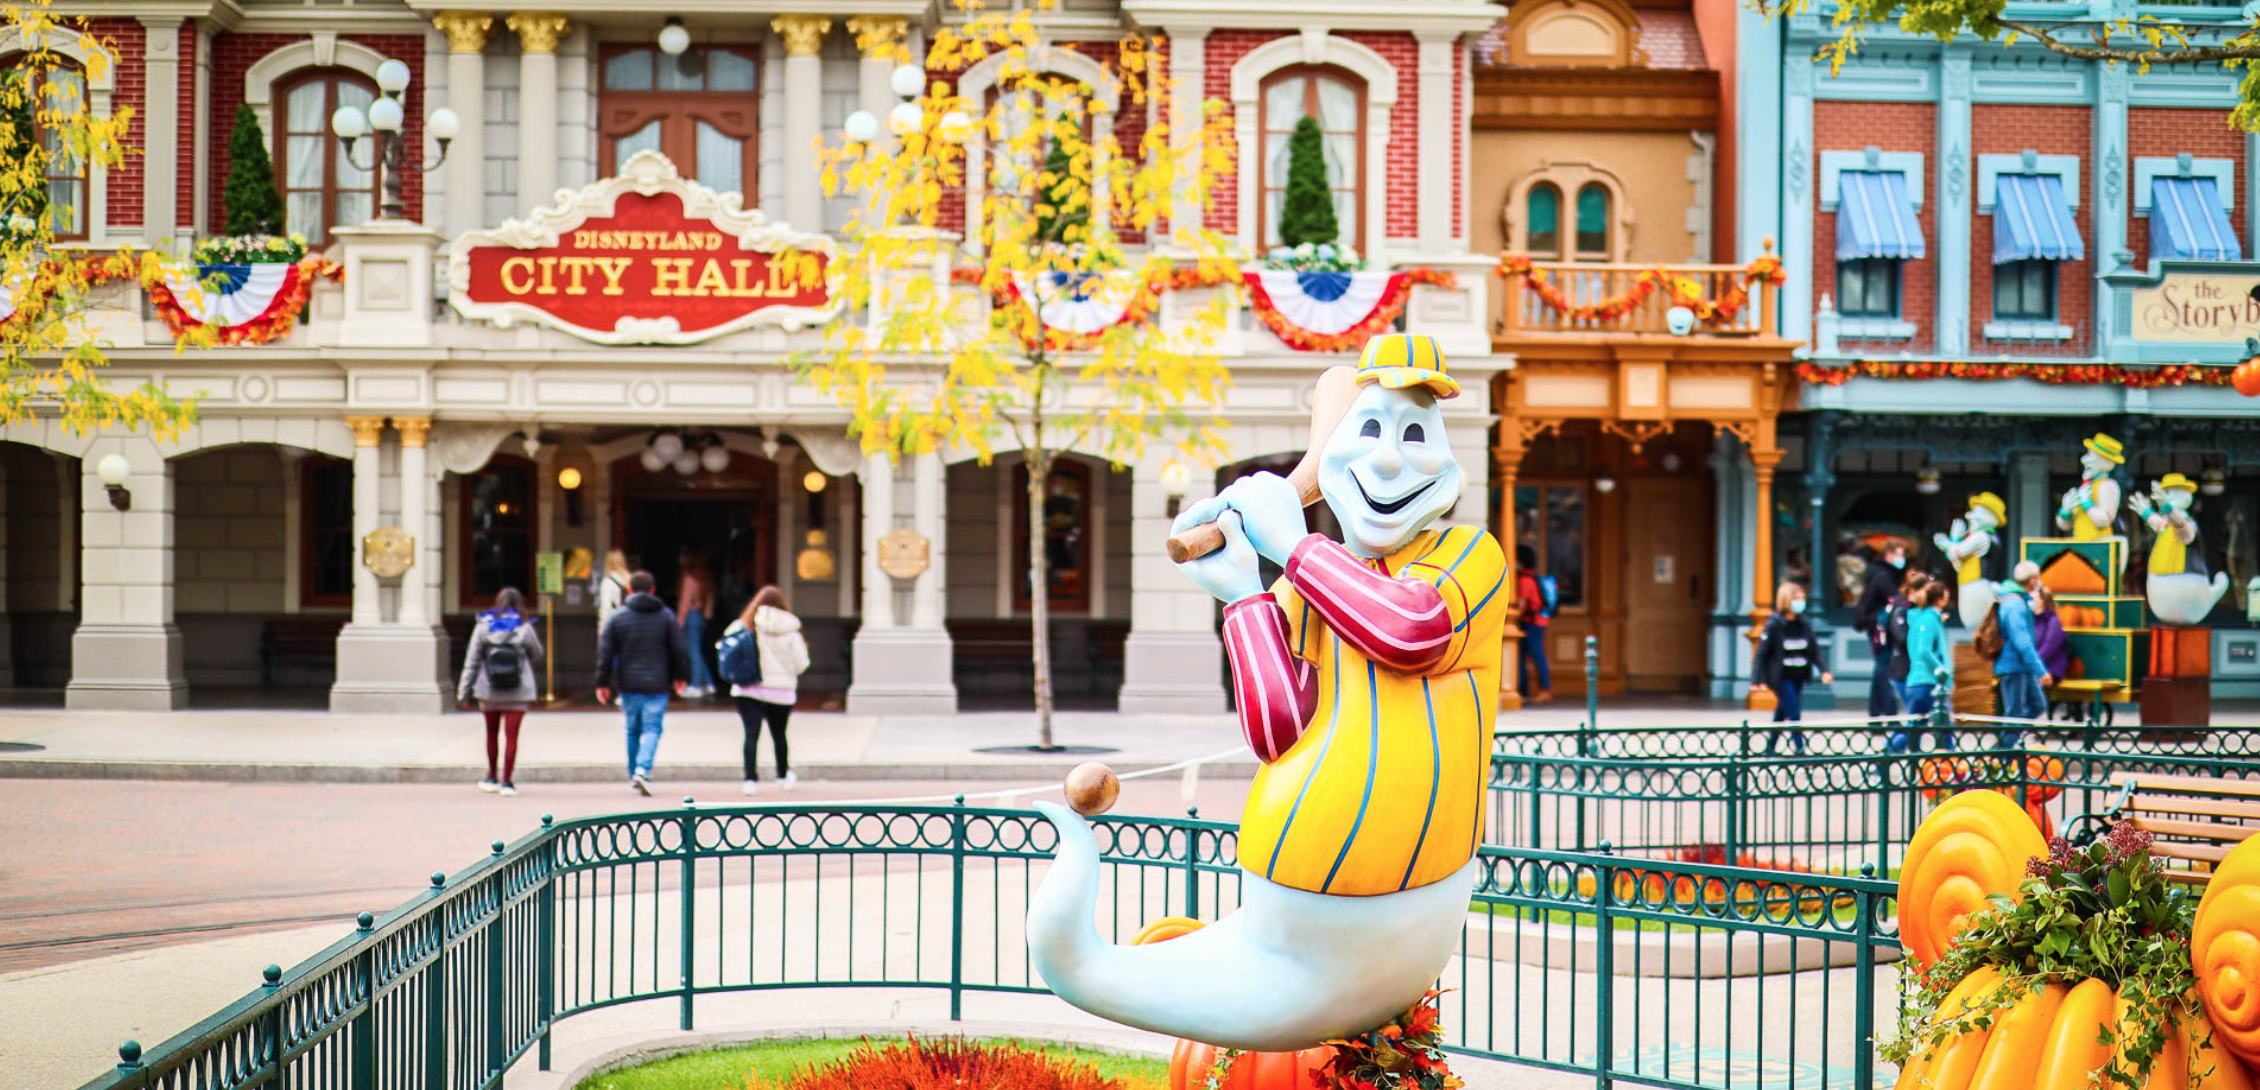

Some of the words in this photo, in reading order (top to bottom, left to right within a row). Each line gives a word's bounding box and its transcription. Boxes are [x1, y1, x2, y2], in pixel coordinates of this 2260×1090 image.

[574, 230, 722, 250] DISNEYLAND
[501, 257, 632, 295] CITY
[650, 259, 798, 298] HALL
[2194, 281, 2224, 299] the
